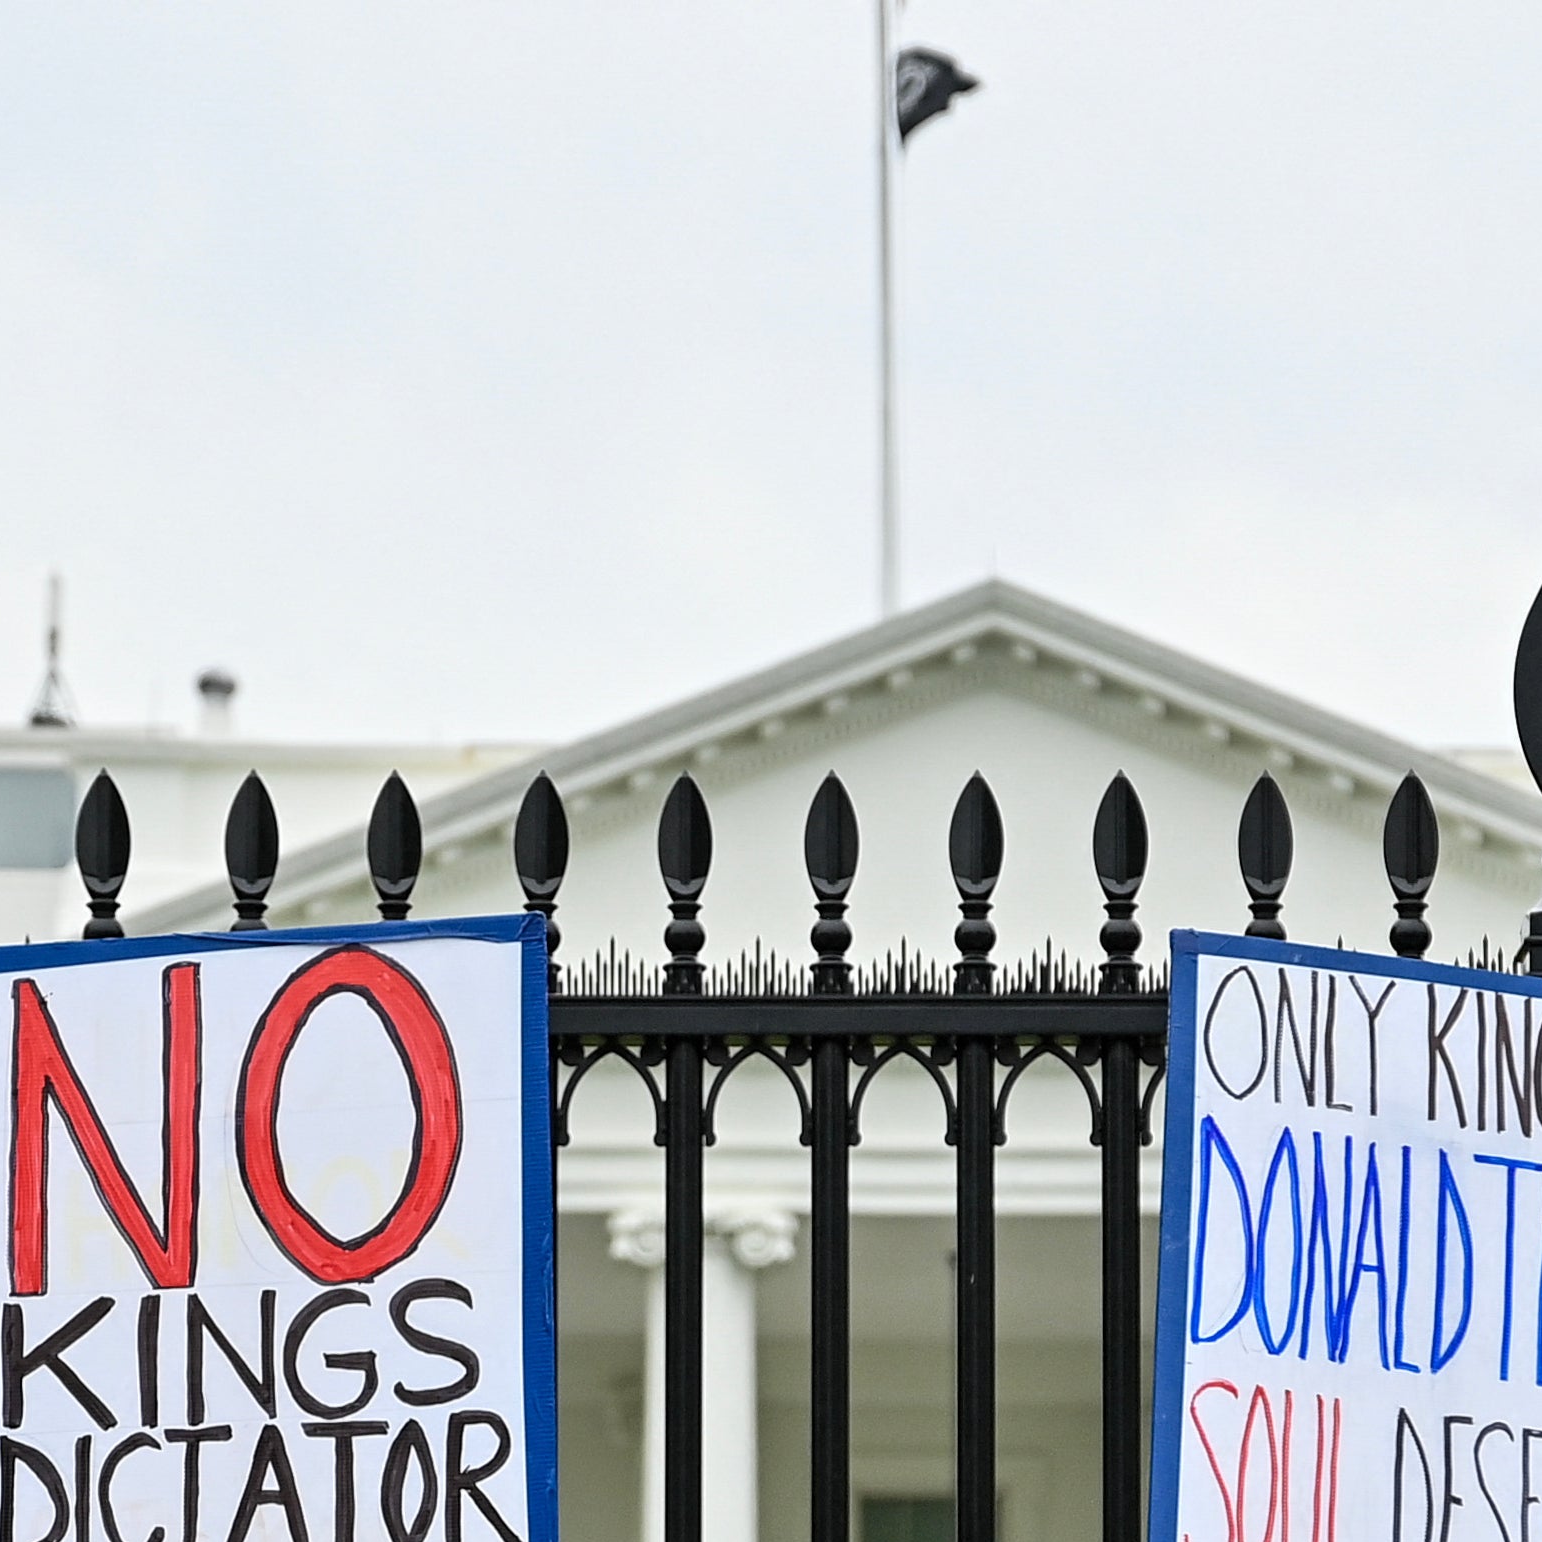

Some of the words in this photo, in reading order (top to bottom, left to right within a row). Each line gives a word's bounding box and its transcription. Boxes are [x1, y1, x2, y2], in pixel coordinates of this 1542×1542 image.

[9, 944, 462, 1296] NO
[1204, 965, 1398, 1118] ONLY
[1190, 1115, 1473, 1373] DONALD
[1, 1279, 480, 1429] KINGS
